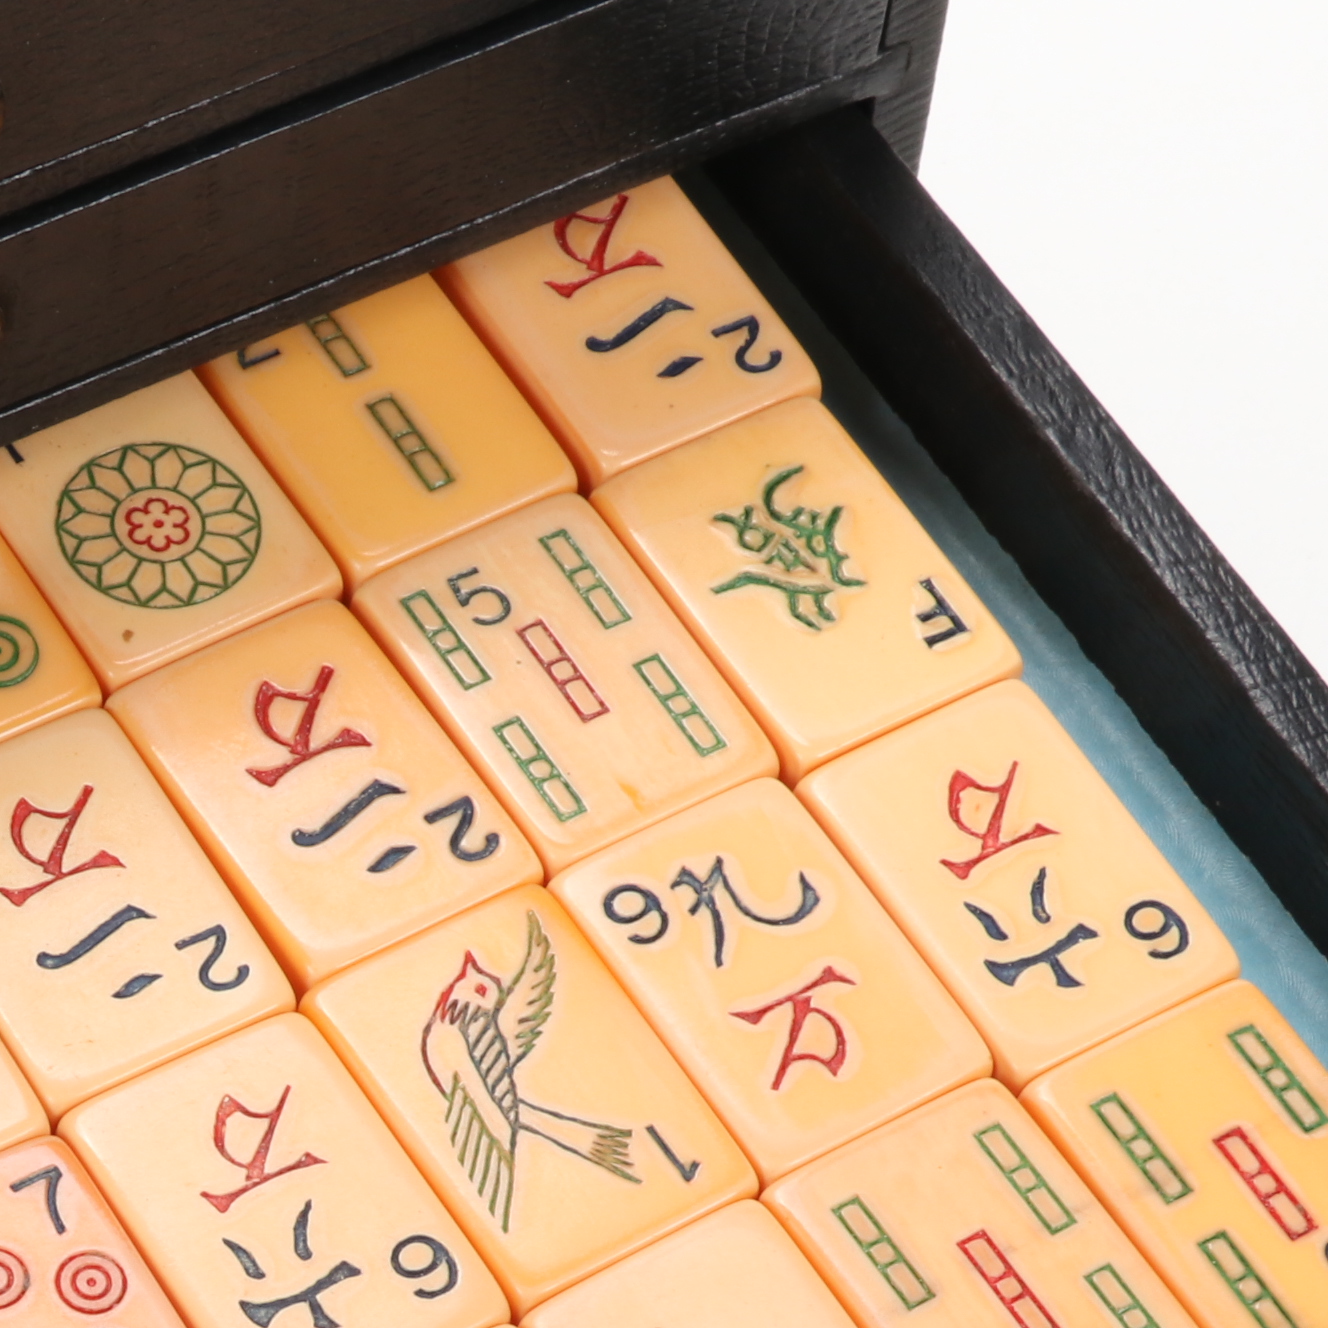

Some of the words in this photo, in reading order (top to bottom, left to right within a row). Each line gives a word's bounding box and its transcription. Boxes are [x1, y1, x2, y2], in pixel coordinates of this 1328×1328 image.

[710, 314, 783, 374] 2
[446, 566, 512, 626] 5
[915, 576, 972, 649] F
[423, 795, 501, 863] 2
[174, 923, 251, 993] 2
[646, 1126, 700, 1182] 1
[10, 1166, 66, 1234] 7
